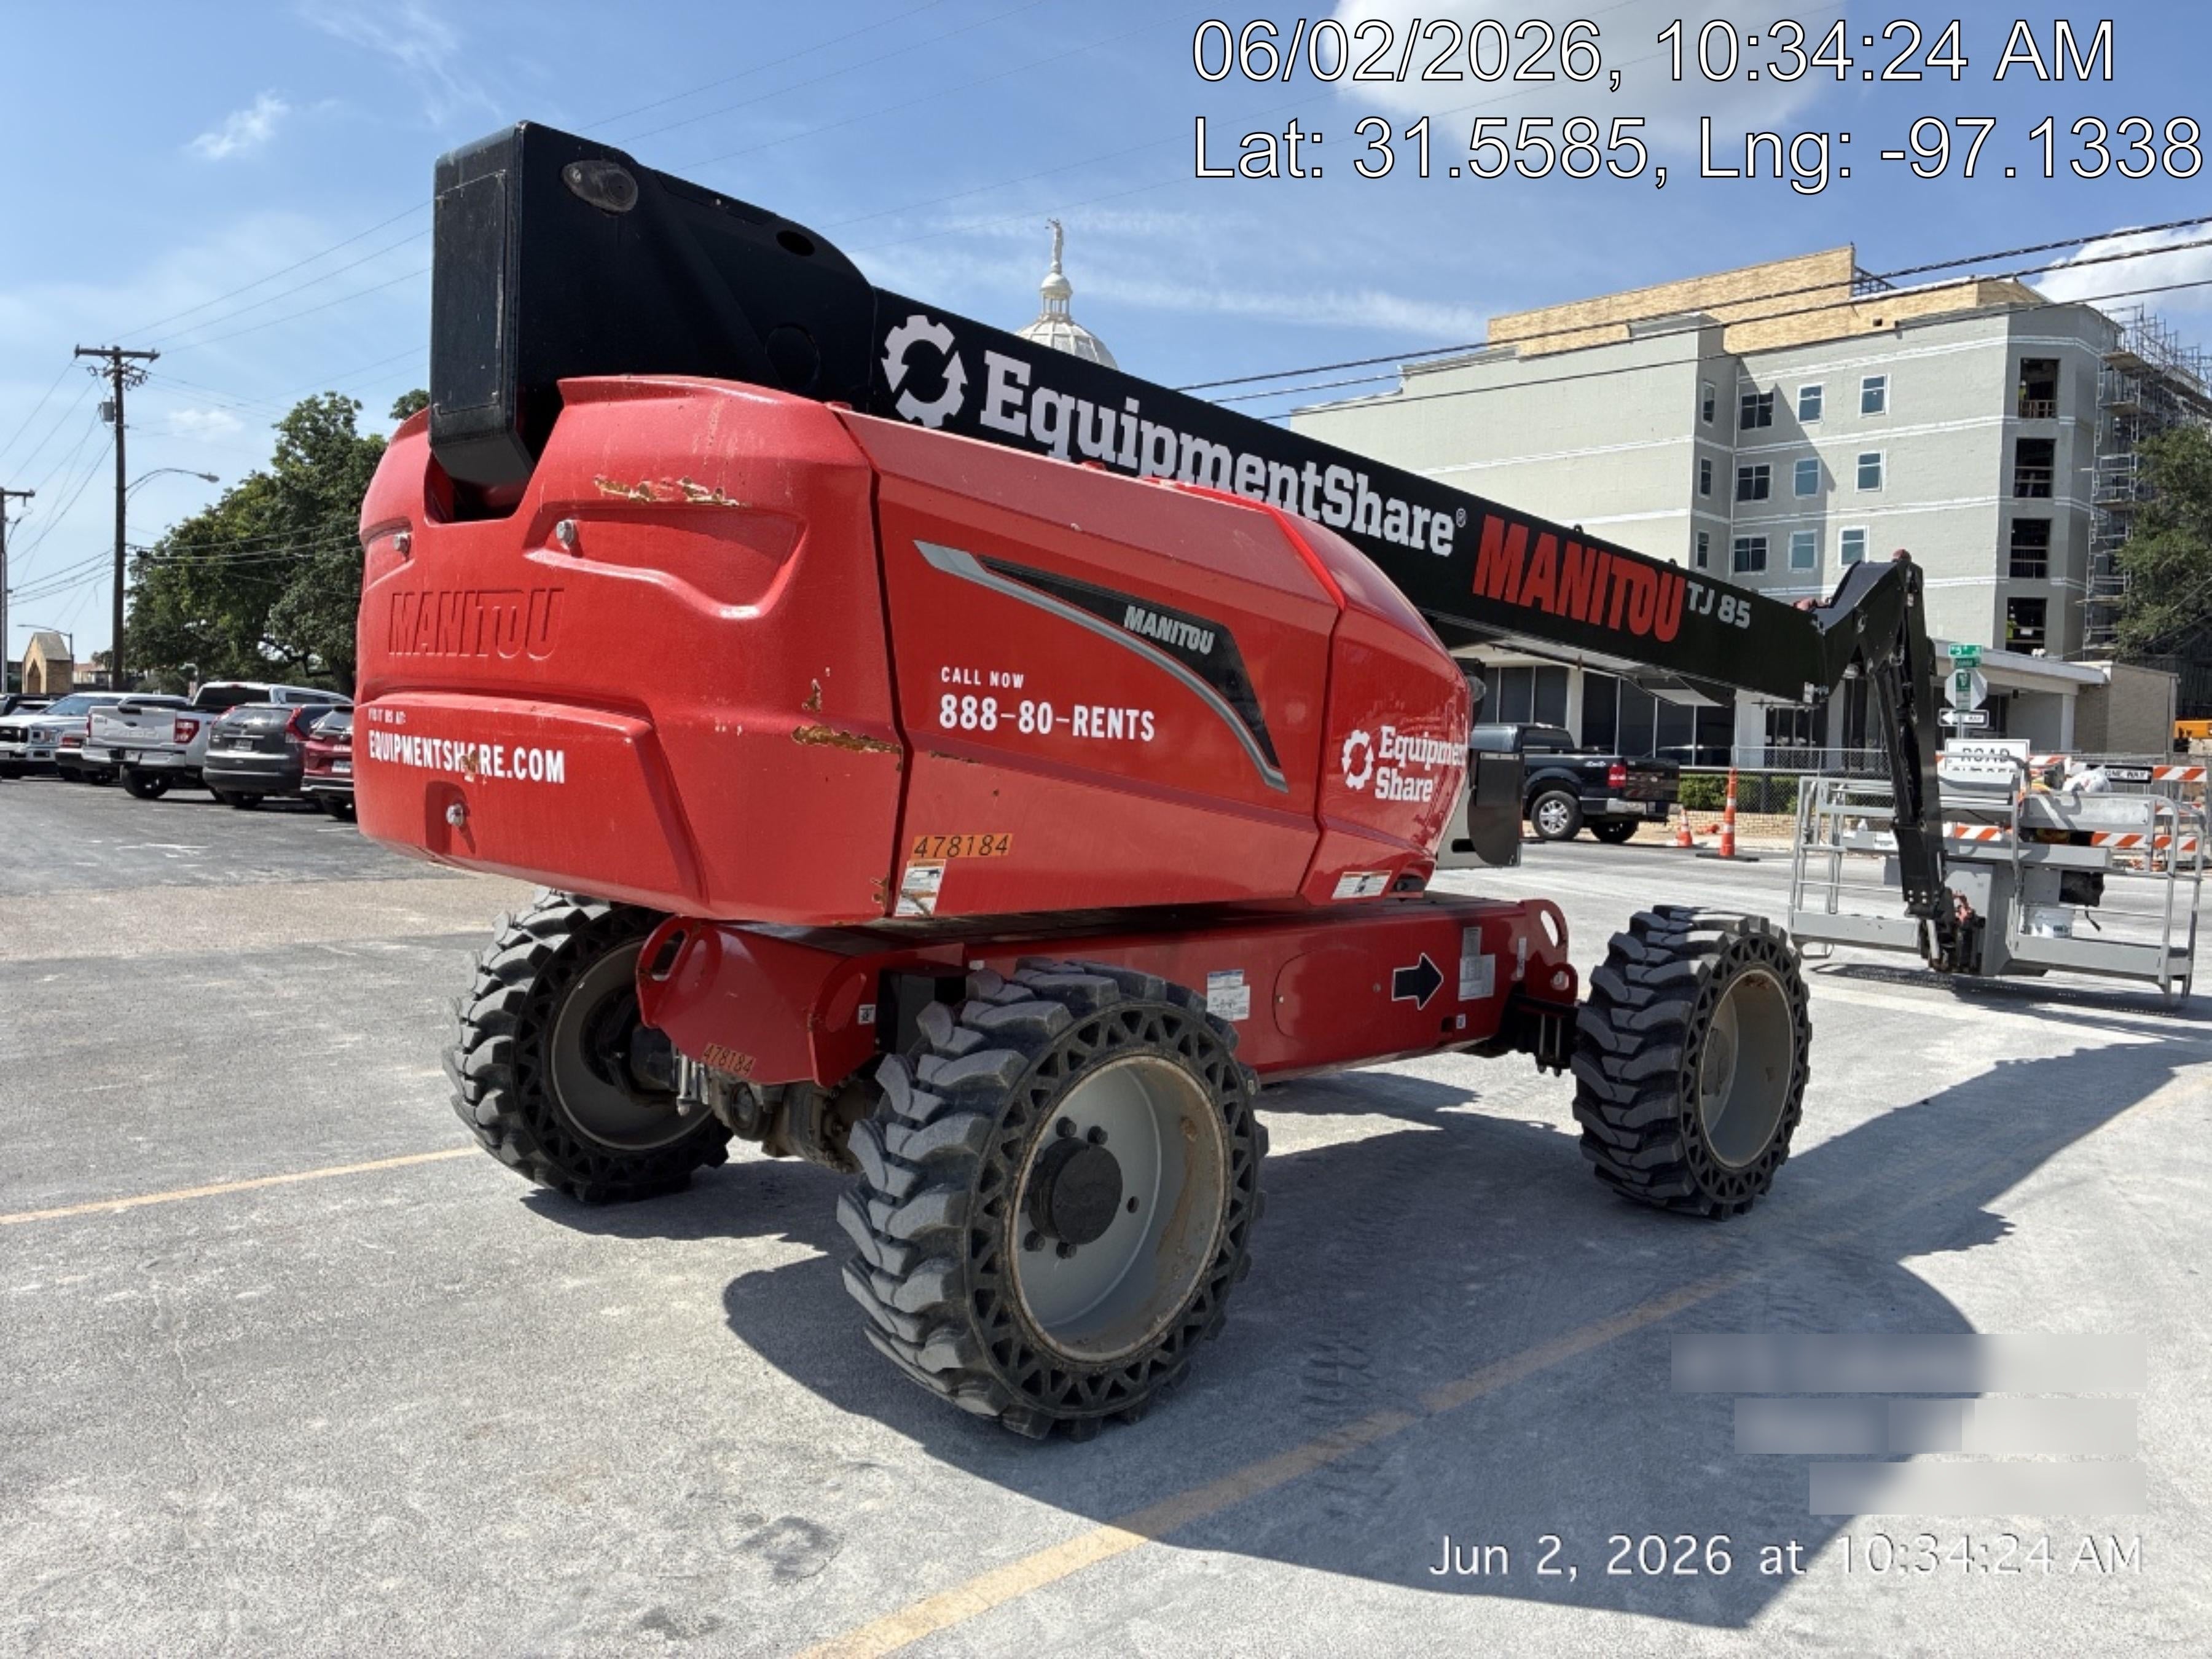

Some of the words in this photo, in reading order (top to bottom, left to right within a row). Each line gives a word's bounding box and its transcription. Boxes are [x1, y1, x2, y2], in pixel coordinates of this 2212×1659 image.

[1472, 514, 1685, 643] MANITOU
[1686, 581, 1716, 615] TJ
[1717, 594, 1751, 630] 85
[388, 587, 564, 661] MANITOU
[1124, 605, 1215, 655] MANITOU
[941, 666, 981, 686] CALL
[990, 670, 1024, 689] NOW
[939, 693, 1155, 742] 888-80-RENTS
[1378, 725, 1467, 771] Equipmen
[1961, 747, 2010, 763] ROAD
[1375, 766, 1433, 802] Share
[914, 834, 1010, 858] 478184
[704, 1045, 753, 1075] 478184
